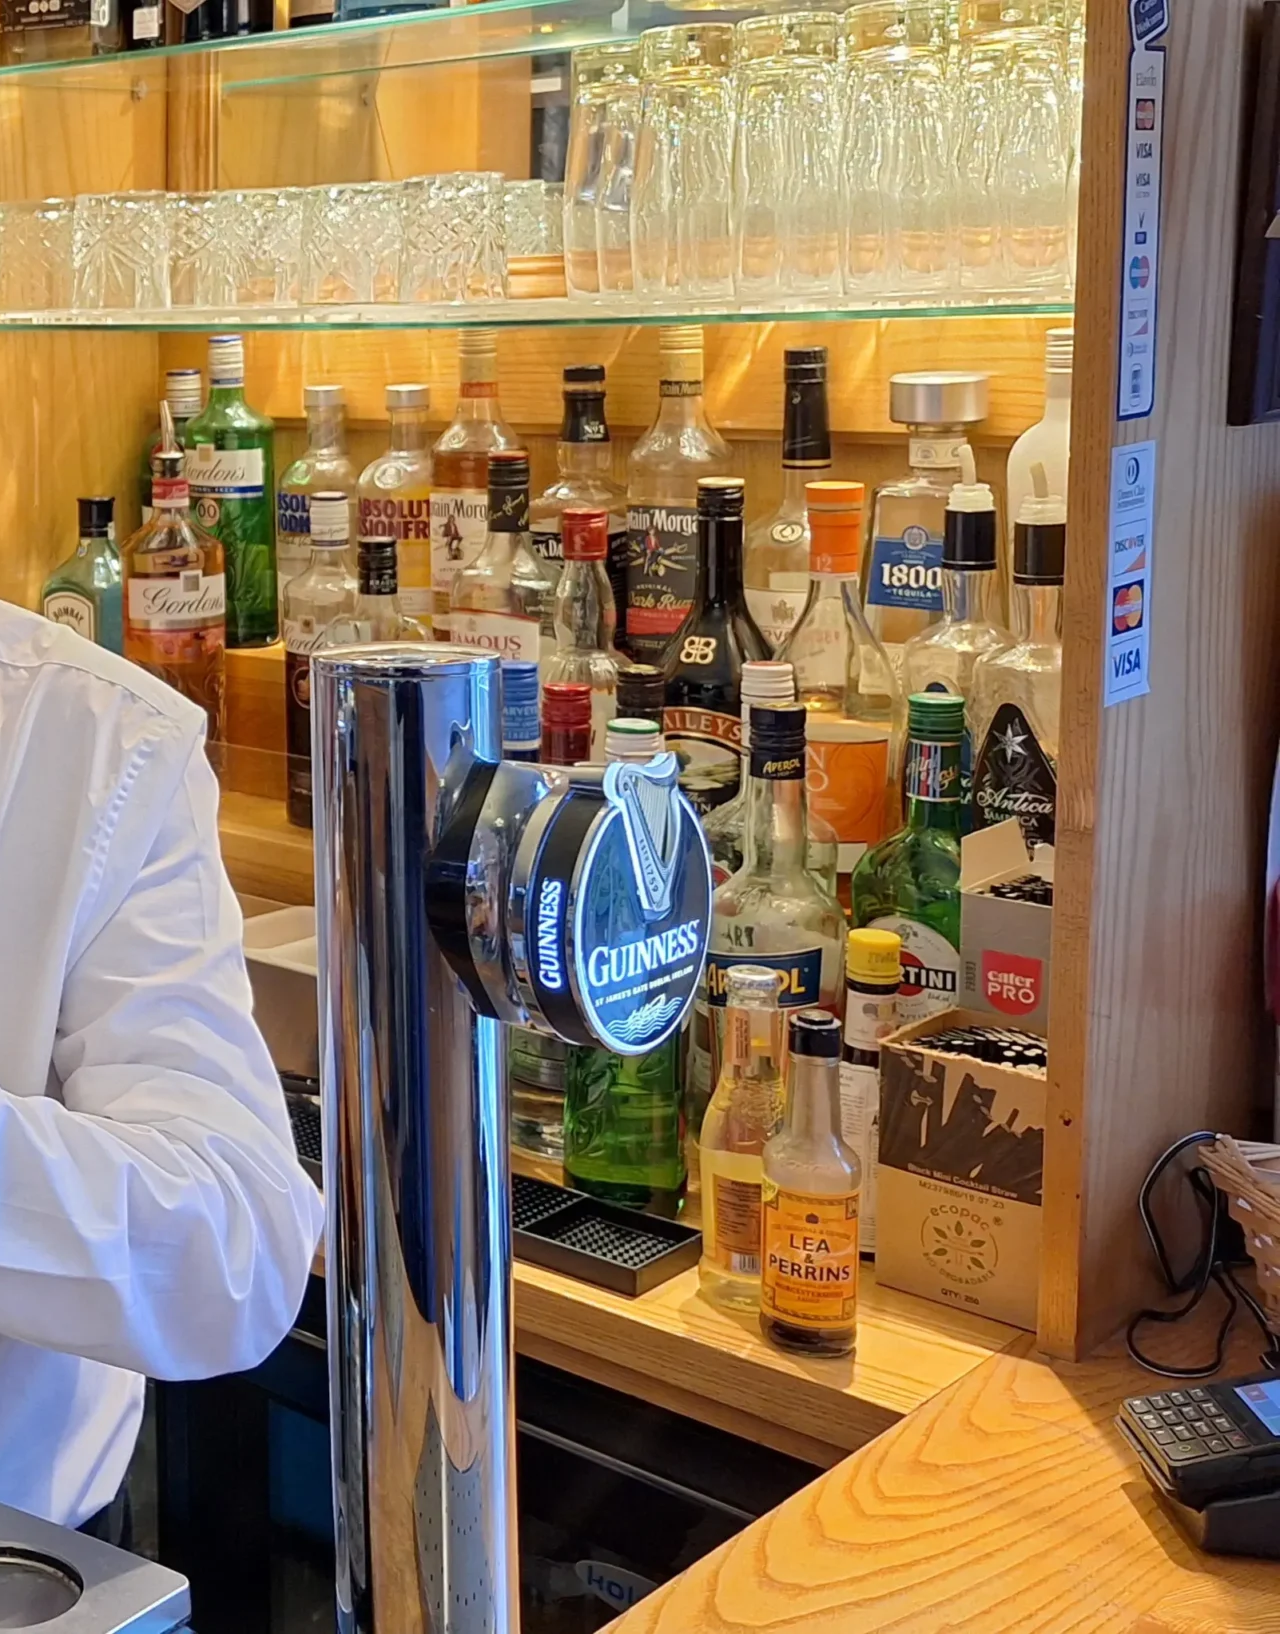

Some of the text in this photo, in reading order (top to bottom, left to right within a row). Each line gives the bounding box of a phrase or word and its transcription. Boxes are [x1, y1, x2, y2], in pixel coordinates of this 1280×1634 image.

[1136, 142, 1152, 158] VISA
[1136, 173, 1150, 187] VISA
[451, 500, 487, 522] Morg
[1115, 534, 1145, 554] DISCOVER
[815, 555, 832, 571] 12
[881, 563, 942, 590] 1800
[892, 589, 932, 598] TEQUILA
[52, 607, 84, 624] BOMBAY
[1113, 648, 1142, 678] VISA
[663, 710, 741, 740] AILEYS
[763, 757, 801, 774] APEROL
[976, 786, 1054, 814] Antica
[538, 878, 563, 990] GUINNESS
[588, 918, 701, 988] GUINNESS
[900, 965, 953, 991] RTINI
[987, 970, 1035, 988] cater
[987, 981, 1035, 1005] PRO
[907, 1162, 1018, 1199] Black Mini Cocktail Straw
[929, 1204, 990, 1231] ecopac
[789, 1233, 831, 1254] LEA
[769, 1253, 851, 1282] PERRINS
[803, 1253, 815, 1265] &
